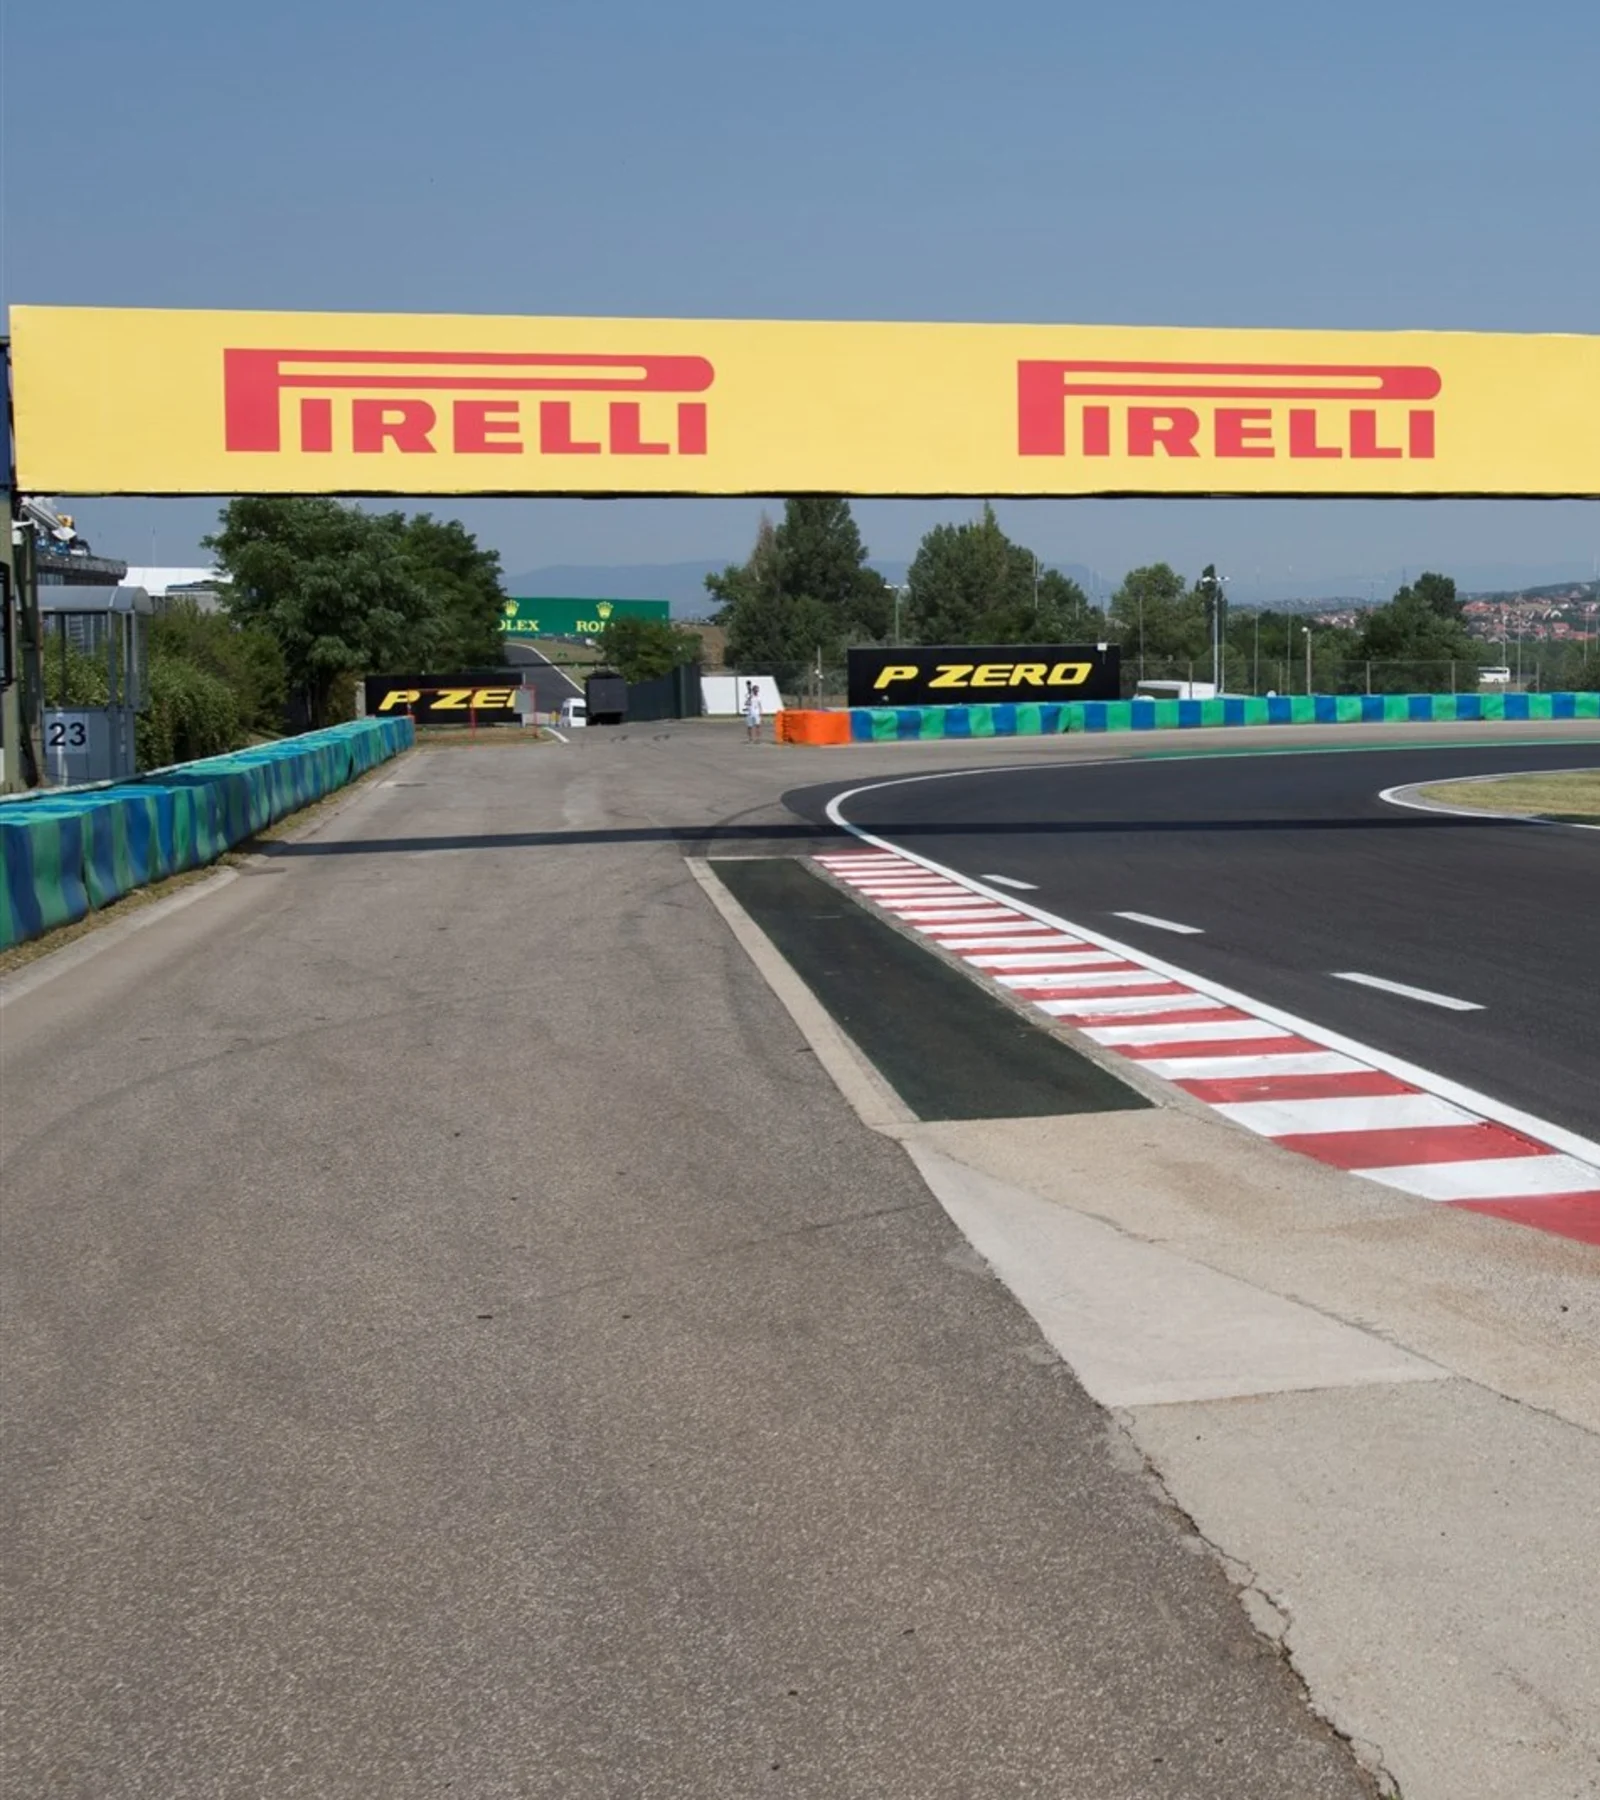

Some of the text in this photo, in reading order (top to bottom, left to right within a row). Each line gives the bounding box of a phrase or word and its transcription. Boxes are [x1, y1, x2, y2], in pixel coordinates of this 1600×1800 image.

[223, 348, 715, 455] PIRELLI
[1017, 360, 1442, 459] PIRELLI
[497, 619, 540, 631] OLEX
[874, 662, 1092, 689] P ZERO
[378, 690, 421, 711] P
[48, 722, 87, 747] 23
